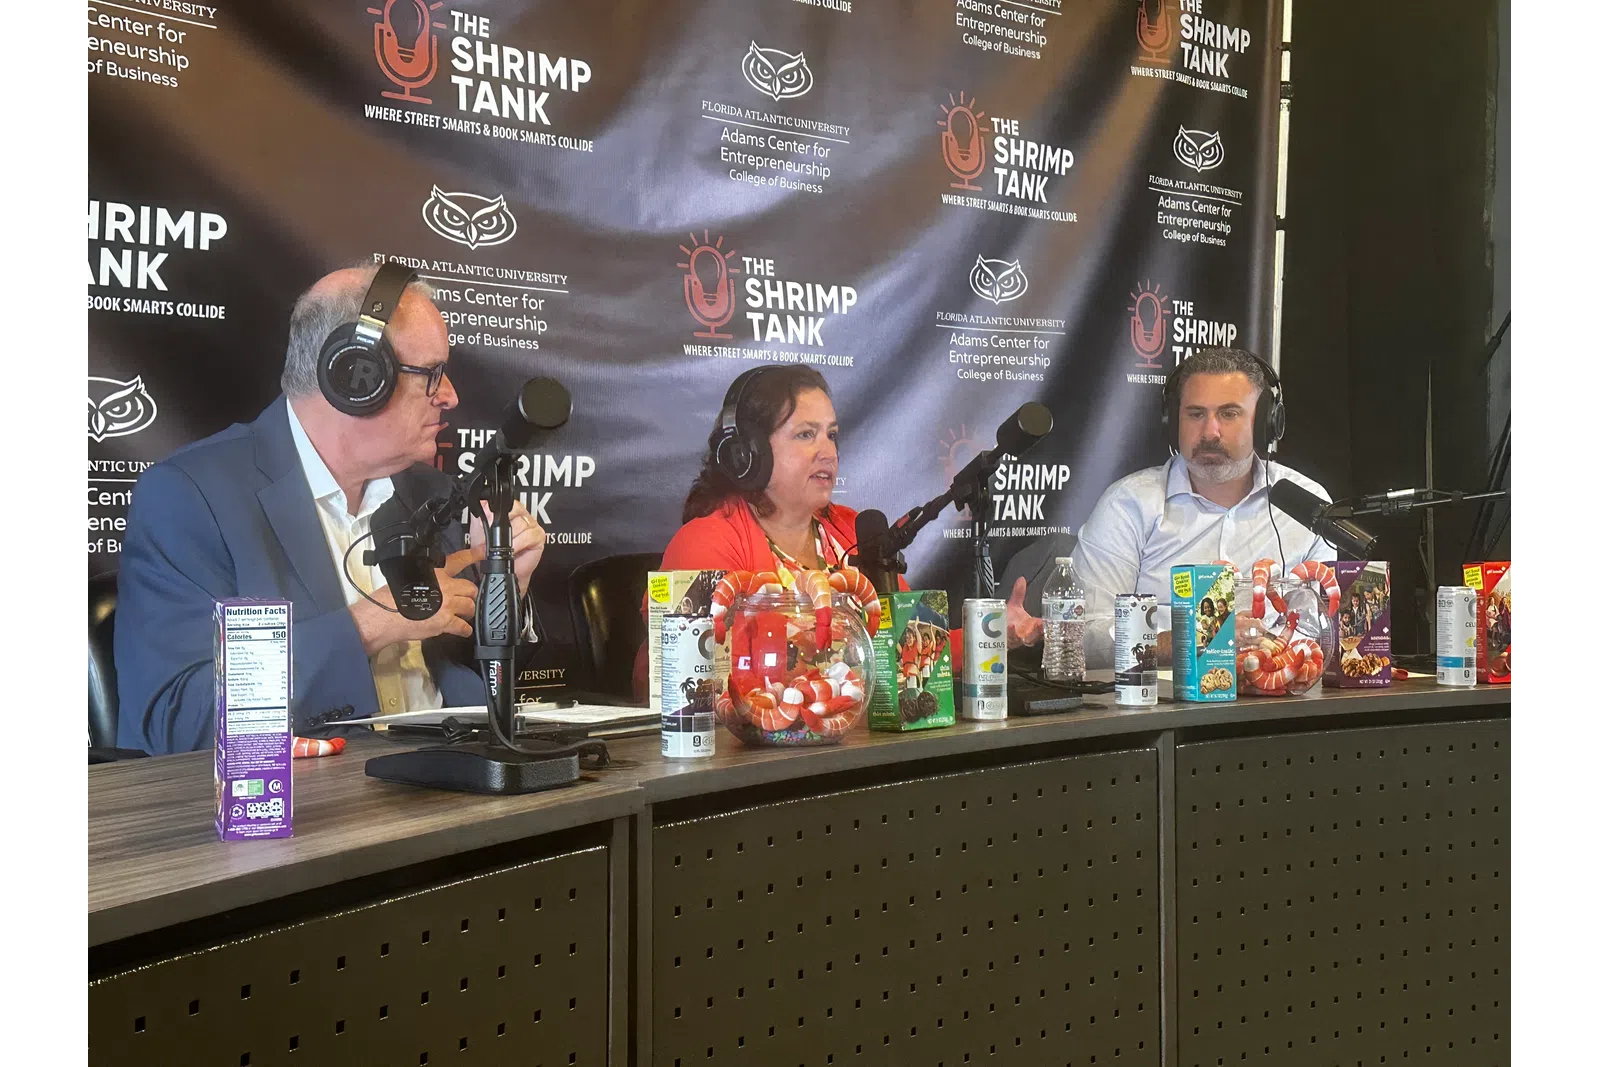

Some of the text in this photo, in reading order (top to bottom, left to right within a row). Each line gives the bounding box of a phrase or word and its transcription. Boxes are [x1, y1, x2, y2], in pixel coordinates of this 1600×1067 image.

[822, 0, 852, 13] COLLIDE
[956, 0, 1046, 28] Adams Center for
[1179, 0, 1203, 14] THE
[88, 7, 187, 44] Center for
[451, 10, 490, 38] THE
[956, 12, 1047, 48] Entrepreneurship
[1180, 13, 1251, 54] SHRIMP
[962, 33, 1041, 60] College of Business
[451, 36, 592, 92] SHRIMP
[1131, 65, 1154, 78] WHERE
[1154, 68, 1175, 80] STREET
[1180, 41, 1230, 79] TANK
[88, 59, 179, 88] of Business
[451, 75, 551, 126] TANK
[364, 104, 594, 152] WHERE STREET SMARTS & BOOK SMARTS COLLIDE
[702, 100, 850, 136] FLORIDA ATLANTIC UNIVERSITY
[990, 117, 1020, 136] THE
[720, 126, 831, 158] Adams Center for
[720, 146, 831, 180] Entrepreneurship
[993, 136, 1074, 176] SHRIMP
[729, 169, 823, 194] College of Business
[993, 166, 1049, 204] TANK
[1148, 174, 1243, 199] FLORIDA ATLANTIC UNIVERSITY
[941, 193, 965, 207] WHERE
[965, 197, 987, 210] STREET
[987, 200, 1009, 213] SMARTS
[1013, 205, 1028, 216] BOOK
[1028, 207, 1050, 220] SMARTS
[1050, 211, 1078, 223] COLLIDE
[1158, 195, 1232, 218] Adams Center for
[1157, 211, 1232, 236] Entrepreneurship
[1163, 229, 1226, 247] College of Business
[432, 260, 494, 277] ATLANTIC
[496, 268, 568, 285] UNIVERSITY
[742, 256, 775, 276] THE
[88, 295, 226, 319] BOOK SMARTS COLLIDE
[465, 288, 516, 308] Center
[521, 294, 545, 311] for
[745, 277, 858, 315] SHRIMP
[1172, 300, 1194, 316] THE
[441, 311, 548, 335] epreneurship
[746, 311, 825, 347] TANK
[936, 311, 1066, 329] FLORIDA ATLANTIC UNIVERSITY
[1172, 317, 1237, 348] SHRIMP
[468, 333, 481, 346] of
[483, 333, 539, 350] Business
[949, 332, 1050, 350] Adams Center for
[683, 344, 854, 367] WHERE STREET SMARTS & BOOK SMARTS COLLIDE
[949, 350, 1051, 369] Entrepreneurship
[1172, 345, 1206, 367] TA
[957, 368, 1044, 382] College of Business
[1126, 373, 1167, 385] WHERE STREET
[457, 451, 596, 488] SRIMP
[994, 463, 1071, 491] SHRIMP
[88, 487, 132, 506] Cent
[992, 494, 1046, 521] TANK
[557, 532, 592, 545] COLLIDE
[943, 528, 965, 539] WHERE
[987, 527, 1006, 538] MARTS
[1011, 527, 1026, 537] BOOK
[1026, 526, 1047, 537] SMARTS
[88, 538, 103, 553] of
[227, 607, 286, 616] Nutrition Facts
[272, 631, 286, 639] 150
[518, 668, 566, 681] ERSITY
